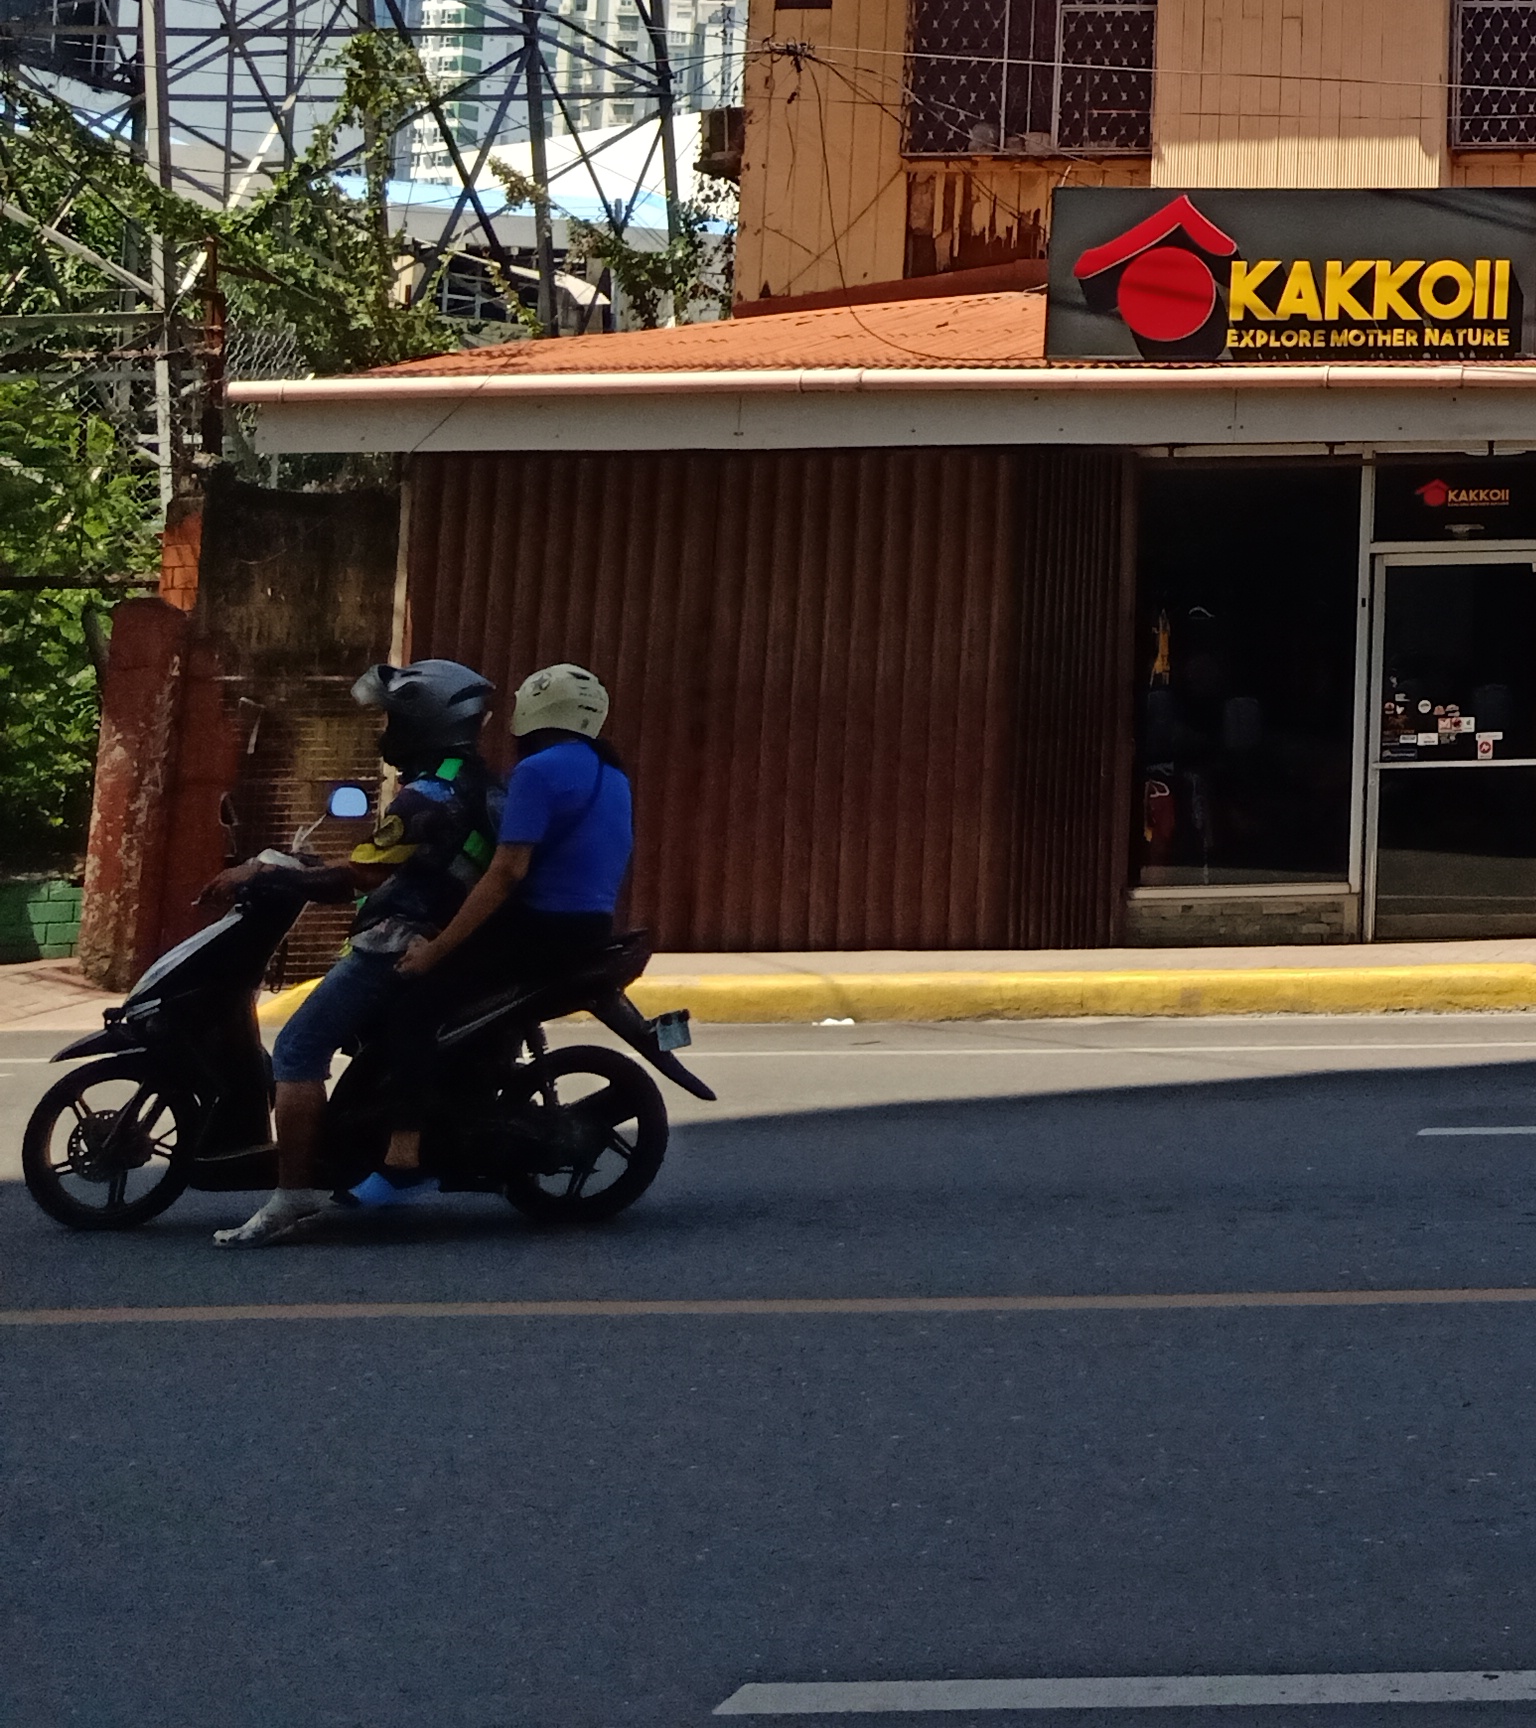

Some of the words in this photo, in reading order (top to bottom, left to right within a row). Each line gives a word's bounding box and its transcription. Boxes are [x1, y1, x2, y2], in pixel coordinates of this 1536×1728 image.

[1229, 259, 1510, 322] KAKKOII
[1226, 328, 1326, 349] EXPLORE
[1329, 328, 1419, 348] MOTHER
[1424, 327, 1510, 347] NATURE
